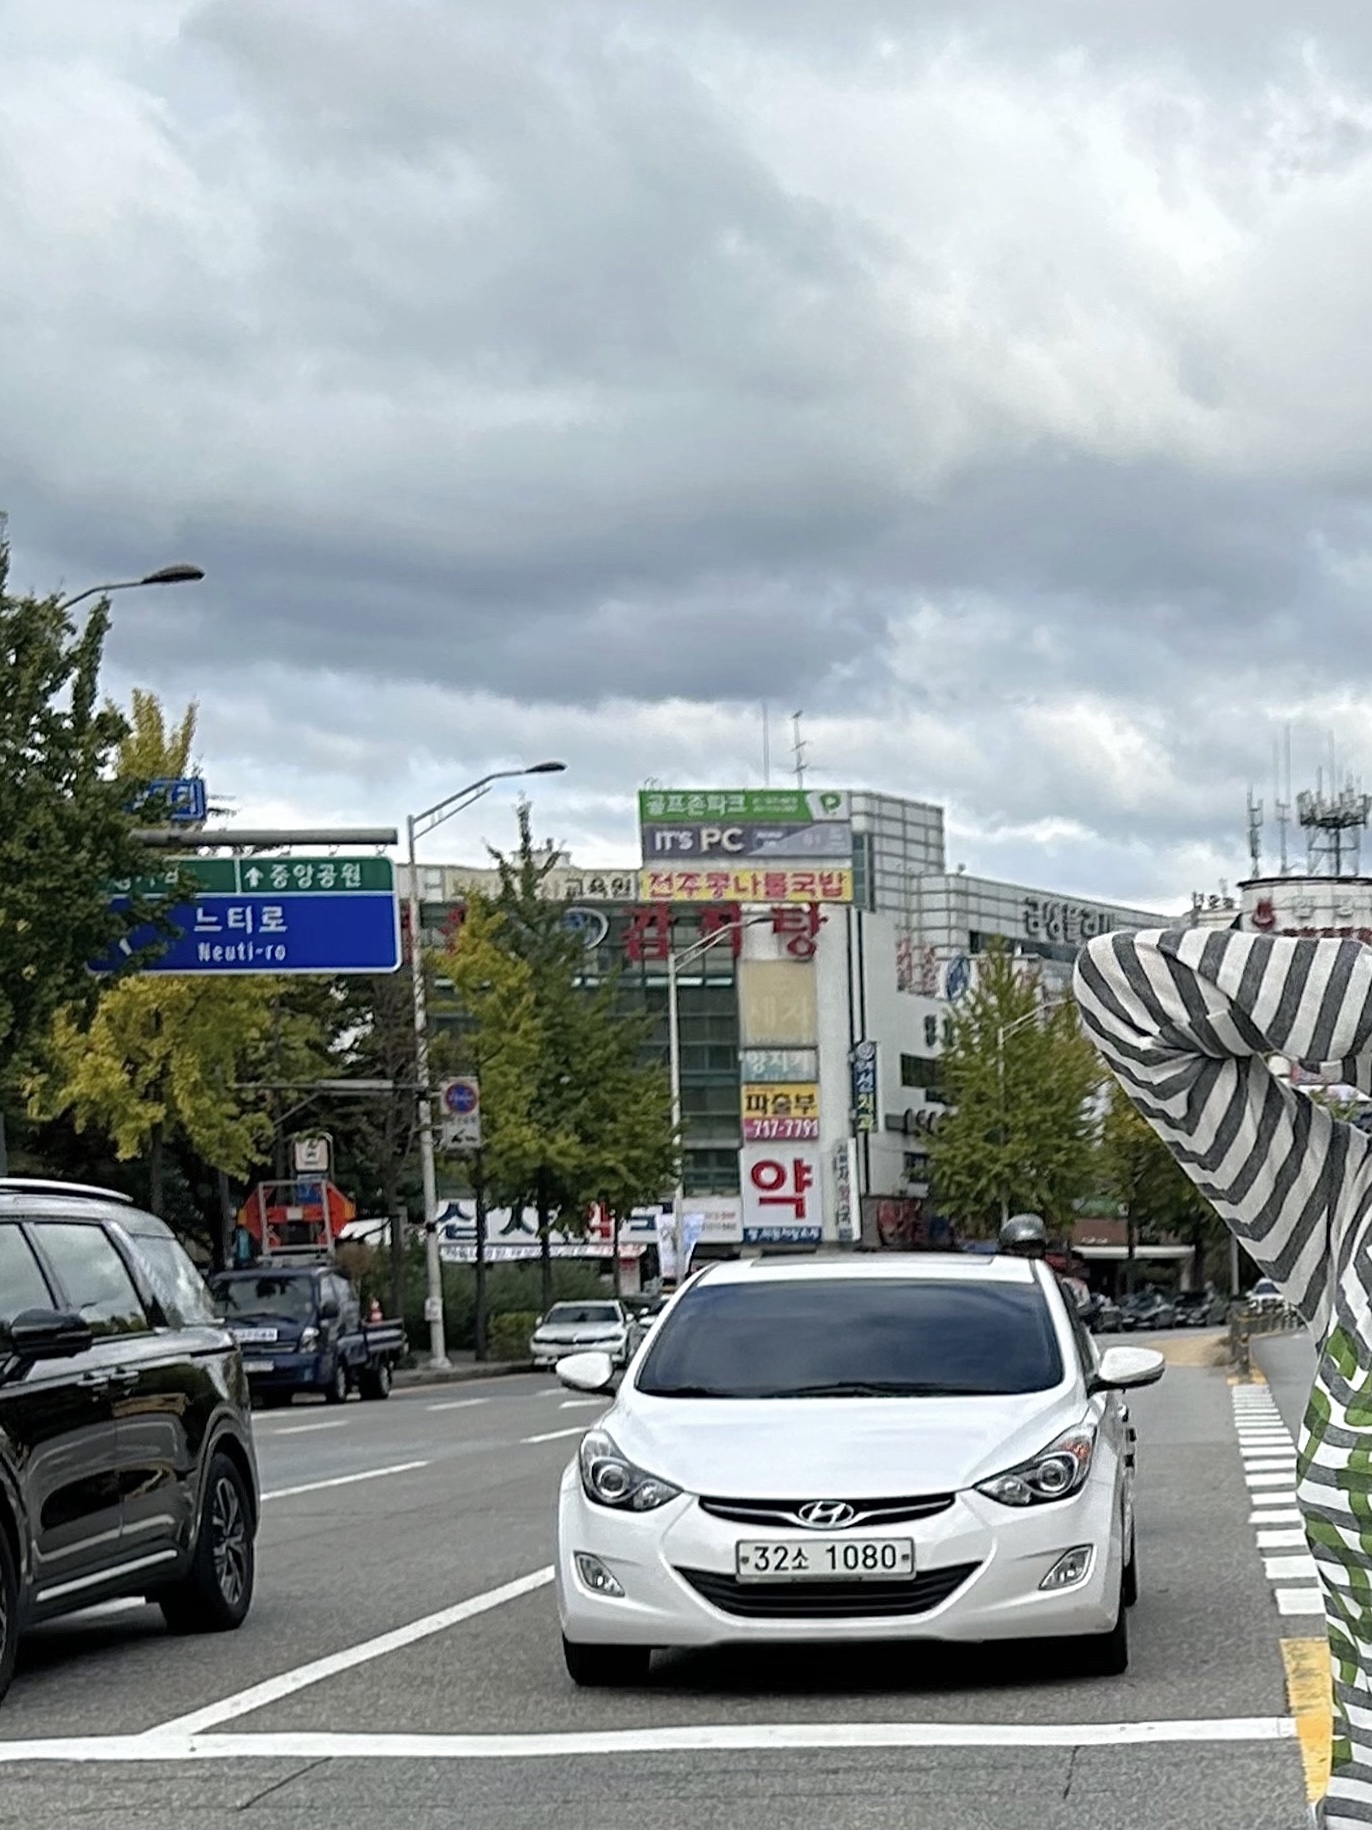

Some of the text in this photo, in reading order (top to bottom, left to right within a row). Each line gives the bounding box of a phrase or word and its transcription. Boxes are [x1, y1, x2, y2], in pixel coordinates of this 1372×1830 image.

[654, 830, 694, 851] IT'S
[700, 827, 744, 852] PC
[269, 863, 362, 889] 중앙공원
[649, 871, 847, 899] 전주콩나물국밥
[193, 904, 288, 934] 느티로
[197, 941, 287, 962] Neuti-ro
[750, 1158, 813, 1220] 약
[753, 1543, 898, 1572] 32소 1080
